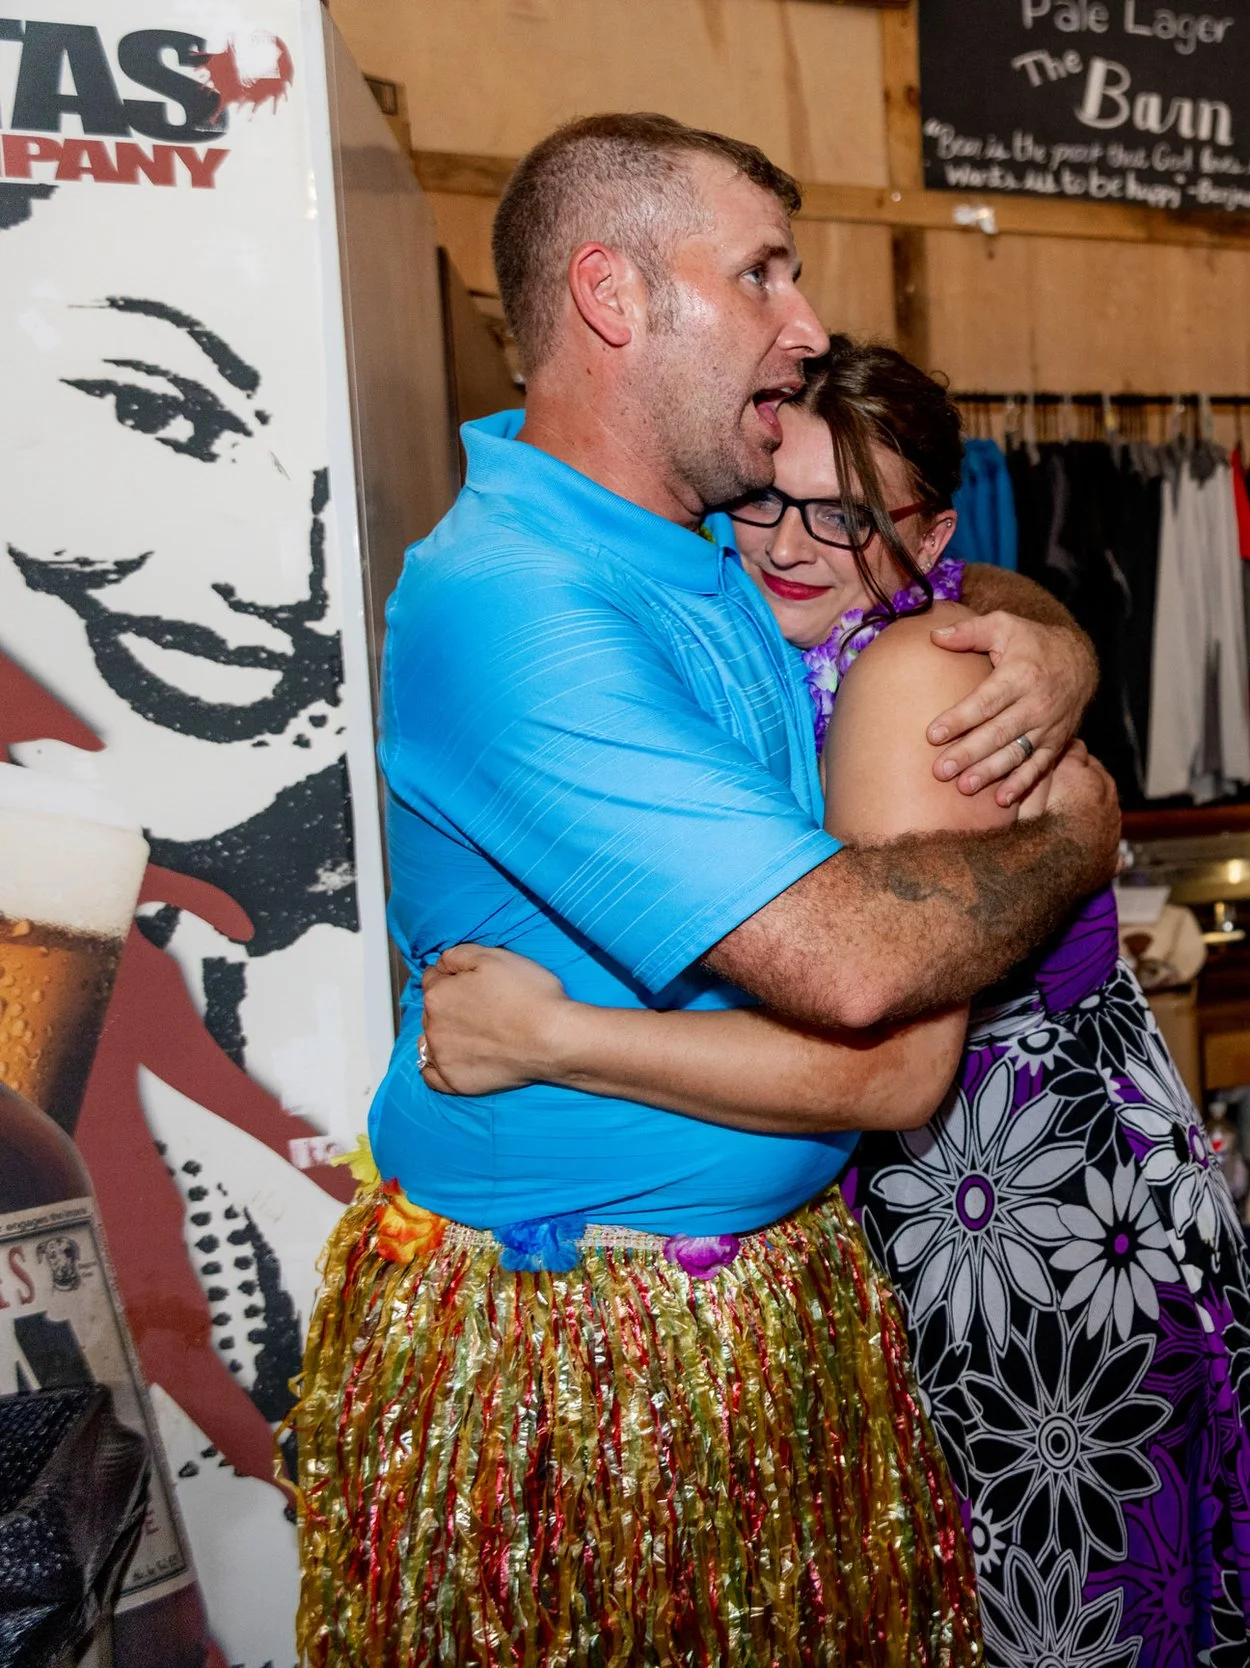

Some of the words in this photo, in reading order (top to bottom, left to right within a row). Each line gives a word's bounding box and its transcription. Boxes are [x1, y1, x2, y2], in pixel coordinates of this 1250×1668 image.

[1021, 0, 1109, 34] Pale
[1124, 0, 1235, 55] Lager
[1011, 49, 1083, 87] The
[1075, 55, 1235, 147] Barn
[1012, 128, 1047, 164] the
[1107, 141, 1150, 170] that
[1152, 142, 1193, 173] God
[1060, 164, 1089, 195] to
[1089, 165, 1125, 198] be
